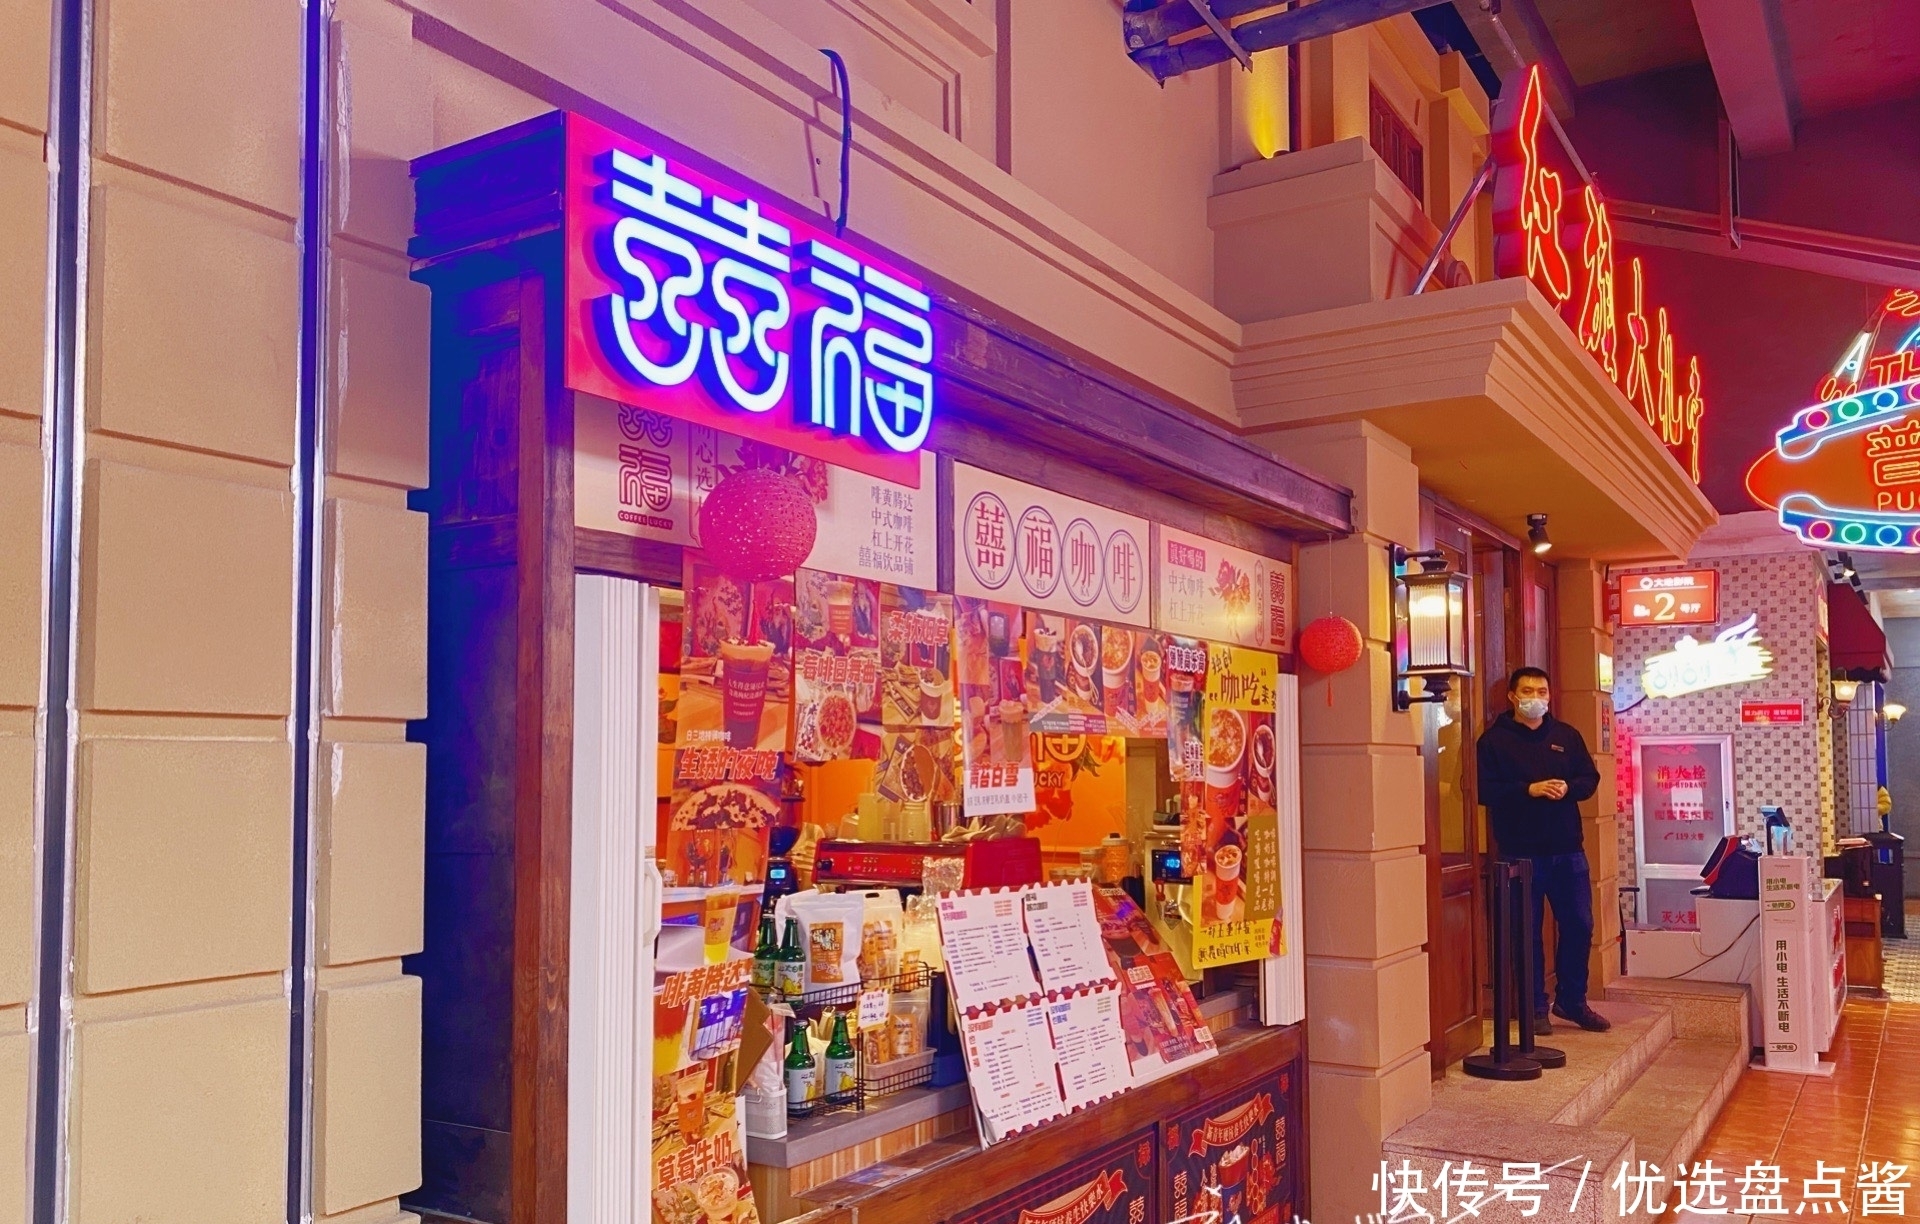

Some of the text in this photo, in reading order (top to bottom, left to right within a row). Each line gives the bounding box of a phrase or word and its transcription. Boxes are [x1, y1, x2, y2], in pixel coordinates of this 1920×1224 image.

[619, 511, 647, 526] COFFEE
[871, 508, 914, 531] 中式咖啡
[872, 530, 914, 555] 杠上开花
[1653, 592, 1676, 621] 2
[678, 746, 779, 781] 生锈的夜晚
[1657, 765, 1706, 780] 消火栓
[1775, 940, 1791, 1033] 用小电 生活不断电
[657, 1130, 733, 1193] 草莓牛奶
